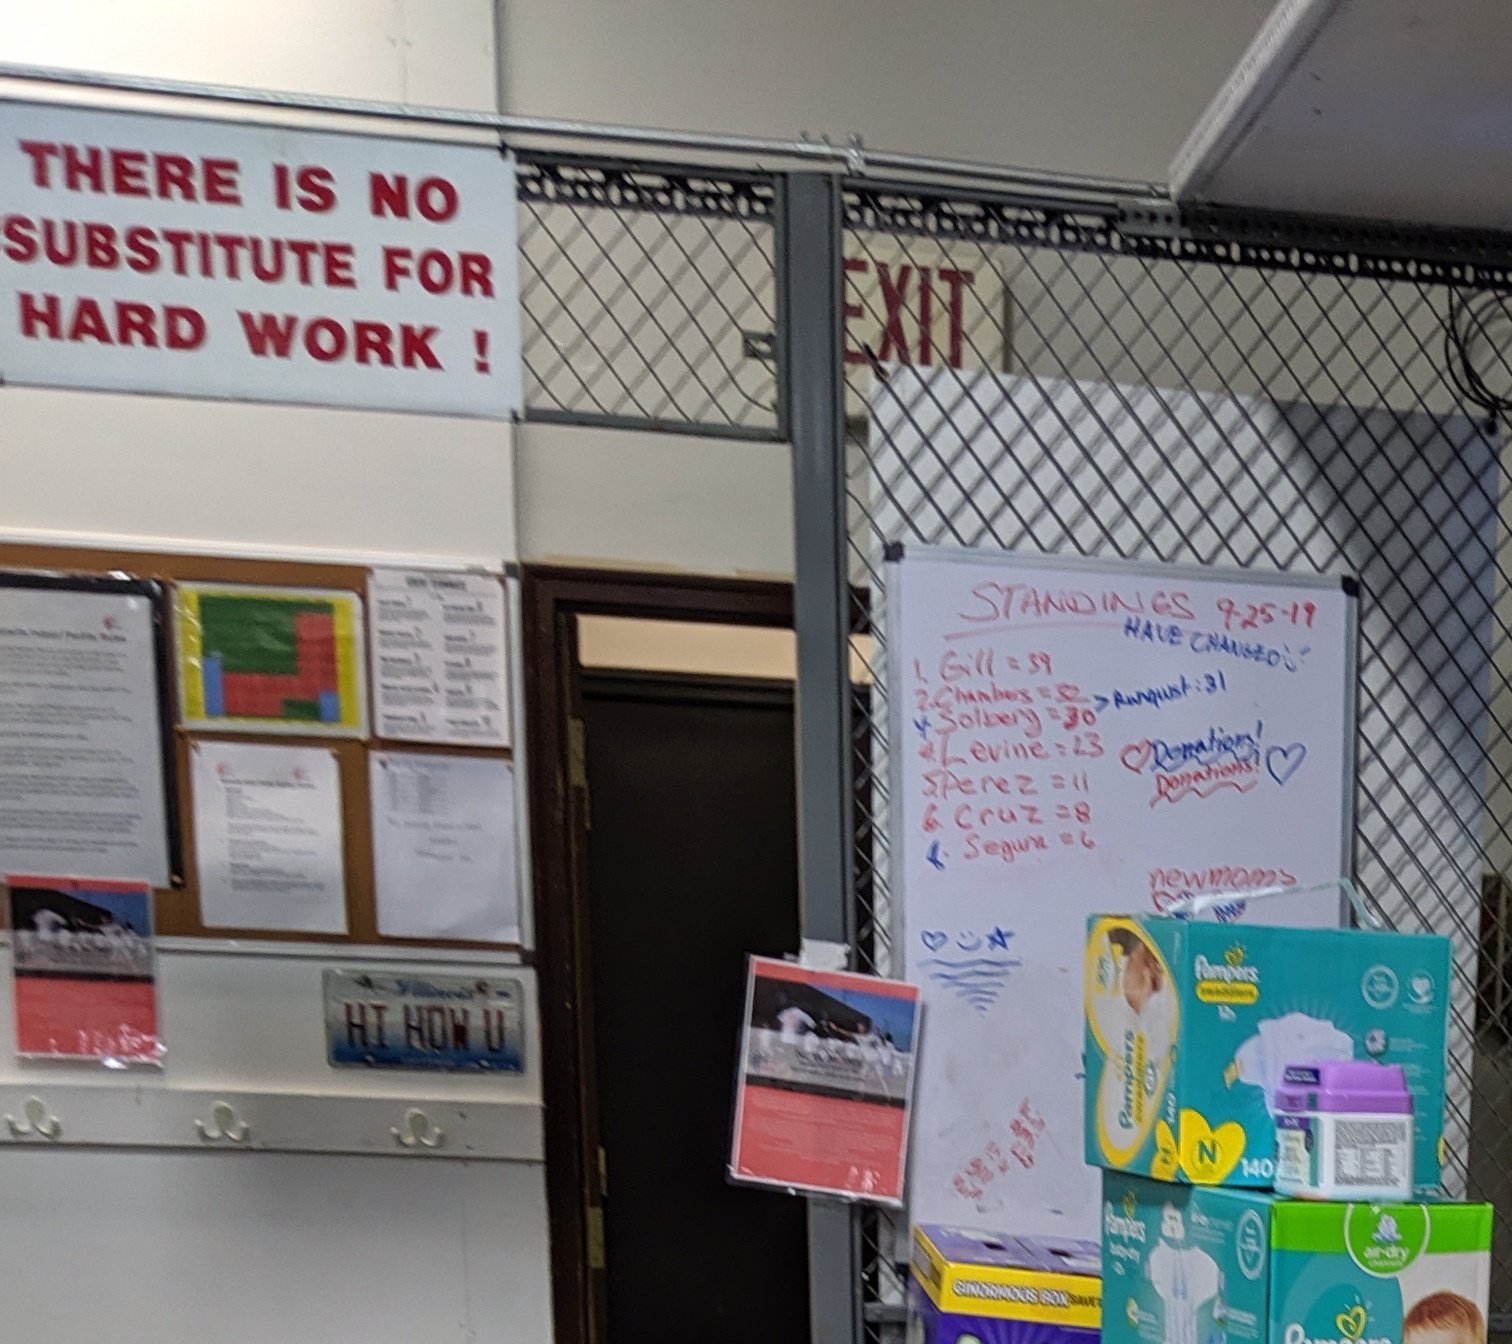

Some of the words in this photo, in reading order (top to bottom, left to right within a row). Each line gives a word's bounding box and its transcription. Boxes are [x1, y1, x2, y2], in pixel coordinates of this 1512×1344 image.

[18, 137, 242, 206] THERE
[273, 163, 336, 213] IS
[371, 173, 459, 222] NO
[2, 214, 357, 289] SUBSTITUTE
[384, 247, 494, 297] FOR
[18, 292, 208, 351] HARD
[239, 311, 444, 370] WORK
[843, 258, 975, 369] EXIT
[958, 581, 1195, 622] STANDINGS
[1124, 615, 1183, 645] HAVE
[940, 650, 994, 682] Gill
[1195, 953, 1260, 984] Pampers
[1117, 1029, 1135, 1130] Pampers
[1197, 1140, 1219, 1165] N
[1241, 1158, 1273, 1178] 140
